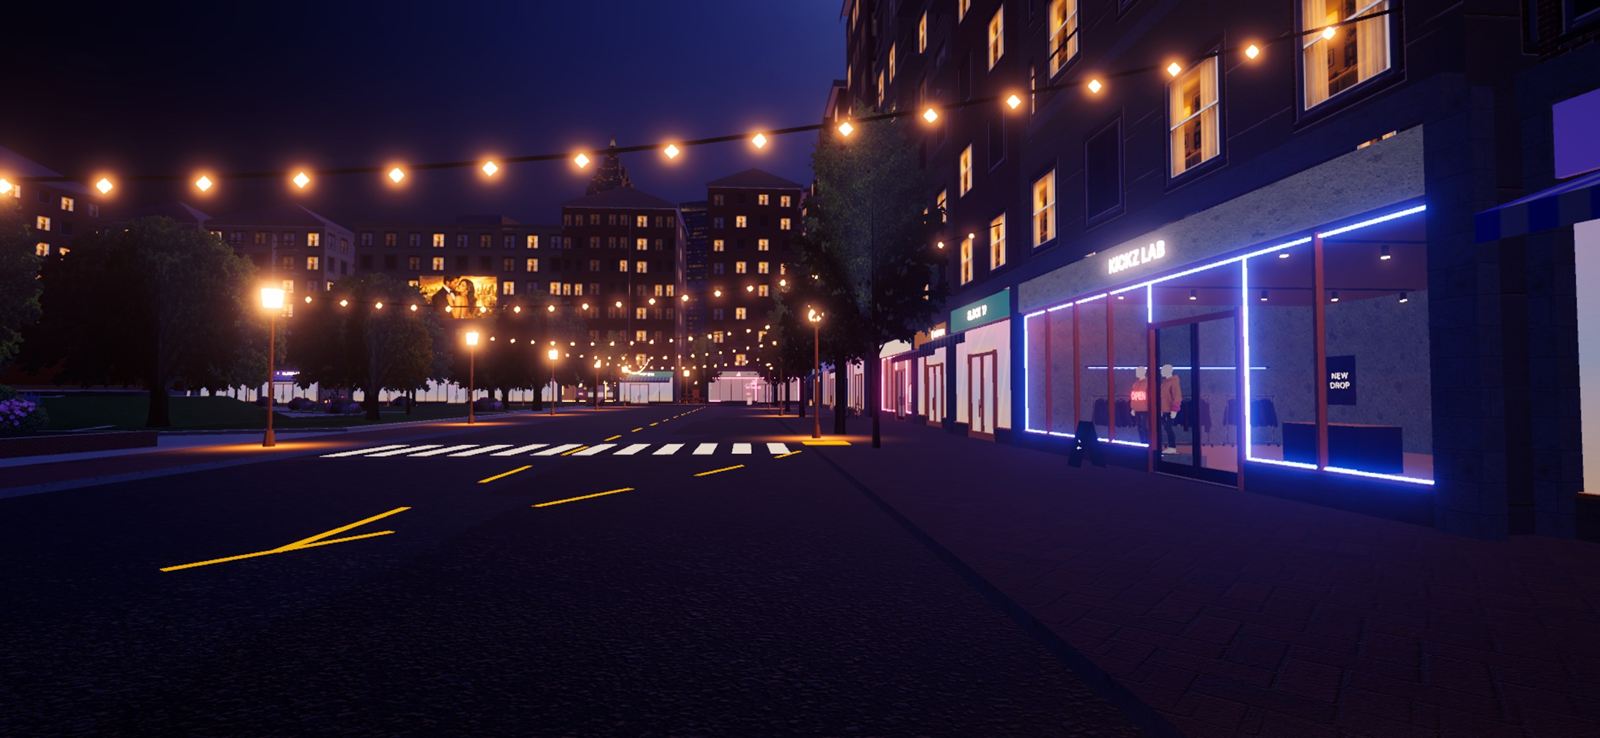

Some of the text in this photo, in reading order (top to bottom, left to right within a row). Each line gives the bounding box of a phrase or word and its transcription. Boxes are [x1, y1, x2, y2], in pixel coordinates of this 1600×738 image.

[1108, 240, 1165, 275] KICKZ LAB
[1331, 372, 1348, 380] NEW
[1330, 381, 1350, 389] DROP
[1131, 391, 1146, 400] OPEN
